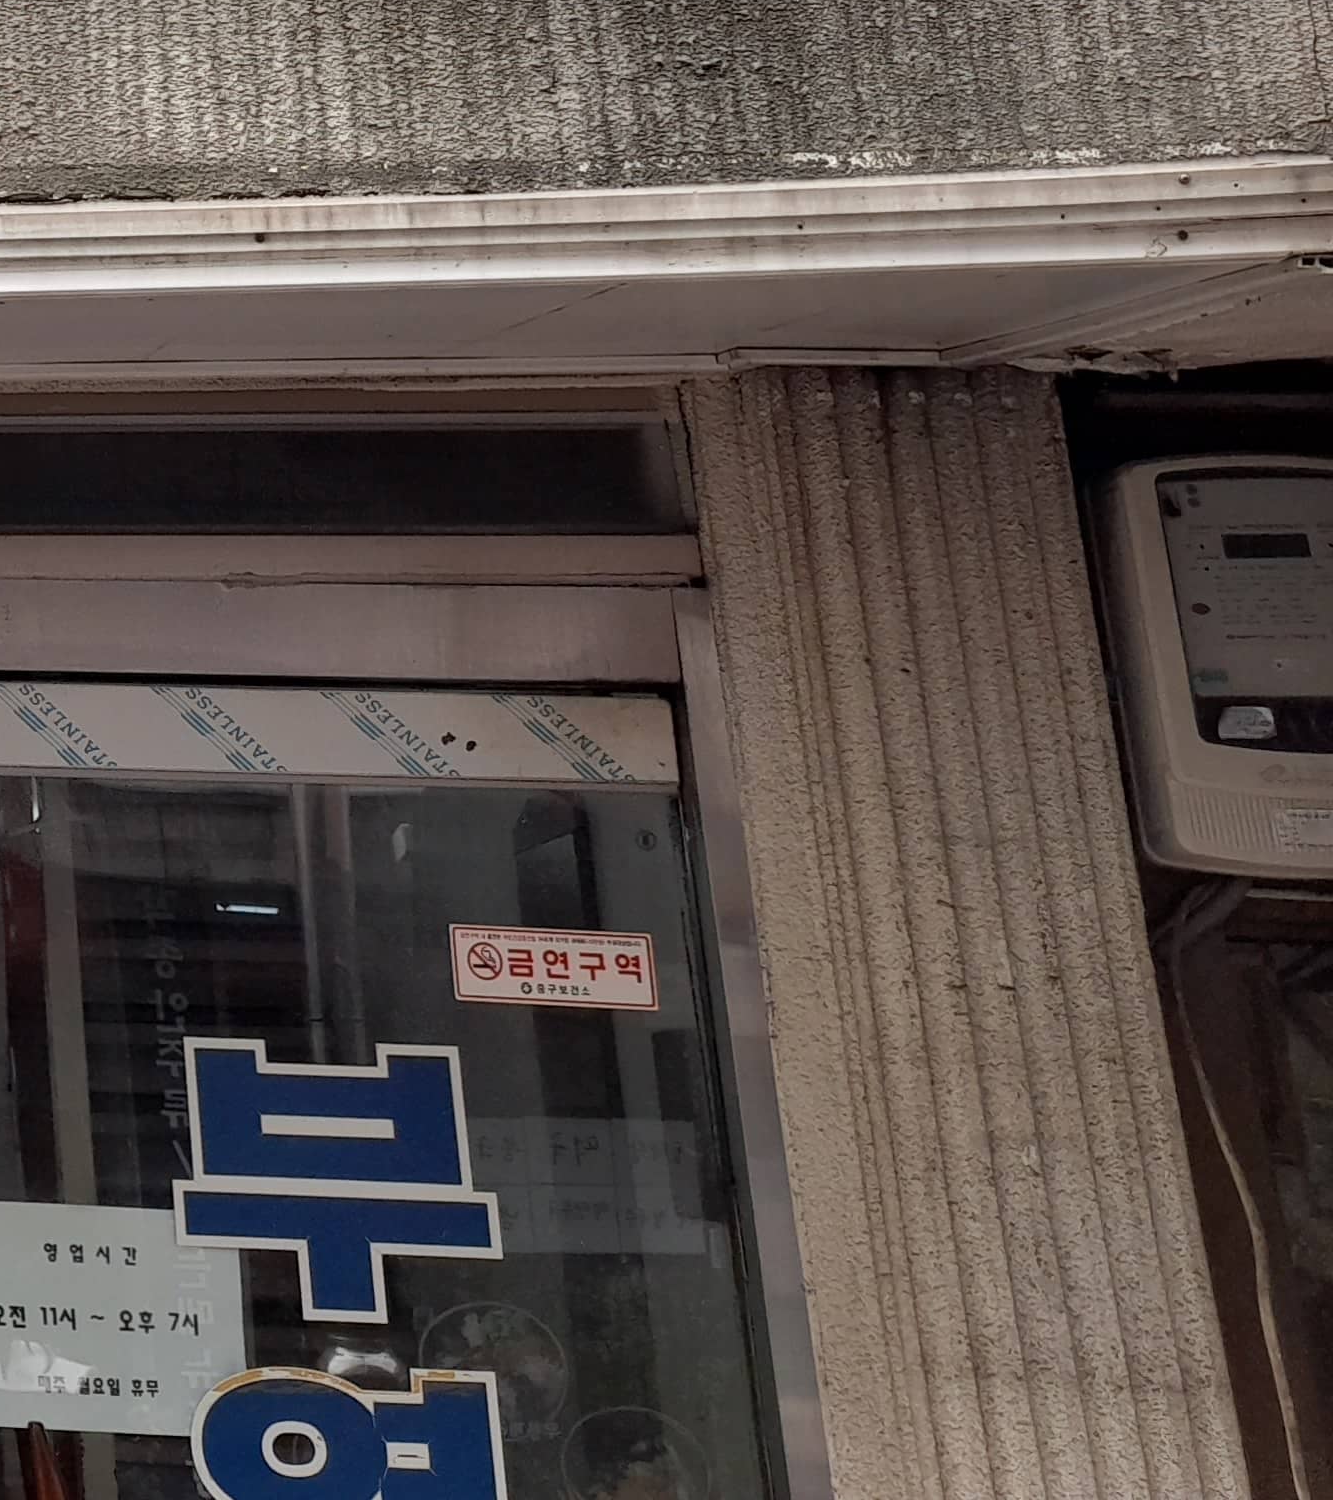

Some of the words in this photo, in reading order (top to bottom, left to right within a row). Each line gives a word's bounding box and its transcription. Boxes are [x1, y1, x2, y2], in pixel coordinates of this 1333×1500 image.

[507, 947, 643, 984] 금연구역
[43, 1242, 138, 1266] 영업시간
[39, 1306, 77, 1331] 11시
[119, 1309, 156, 1333] 오후
[168, 1312, 200, 1336] 7시
[131, 1378, 160, 1398] 휴무
